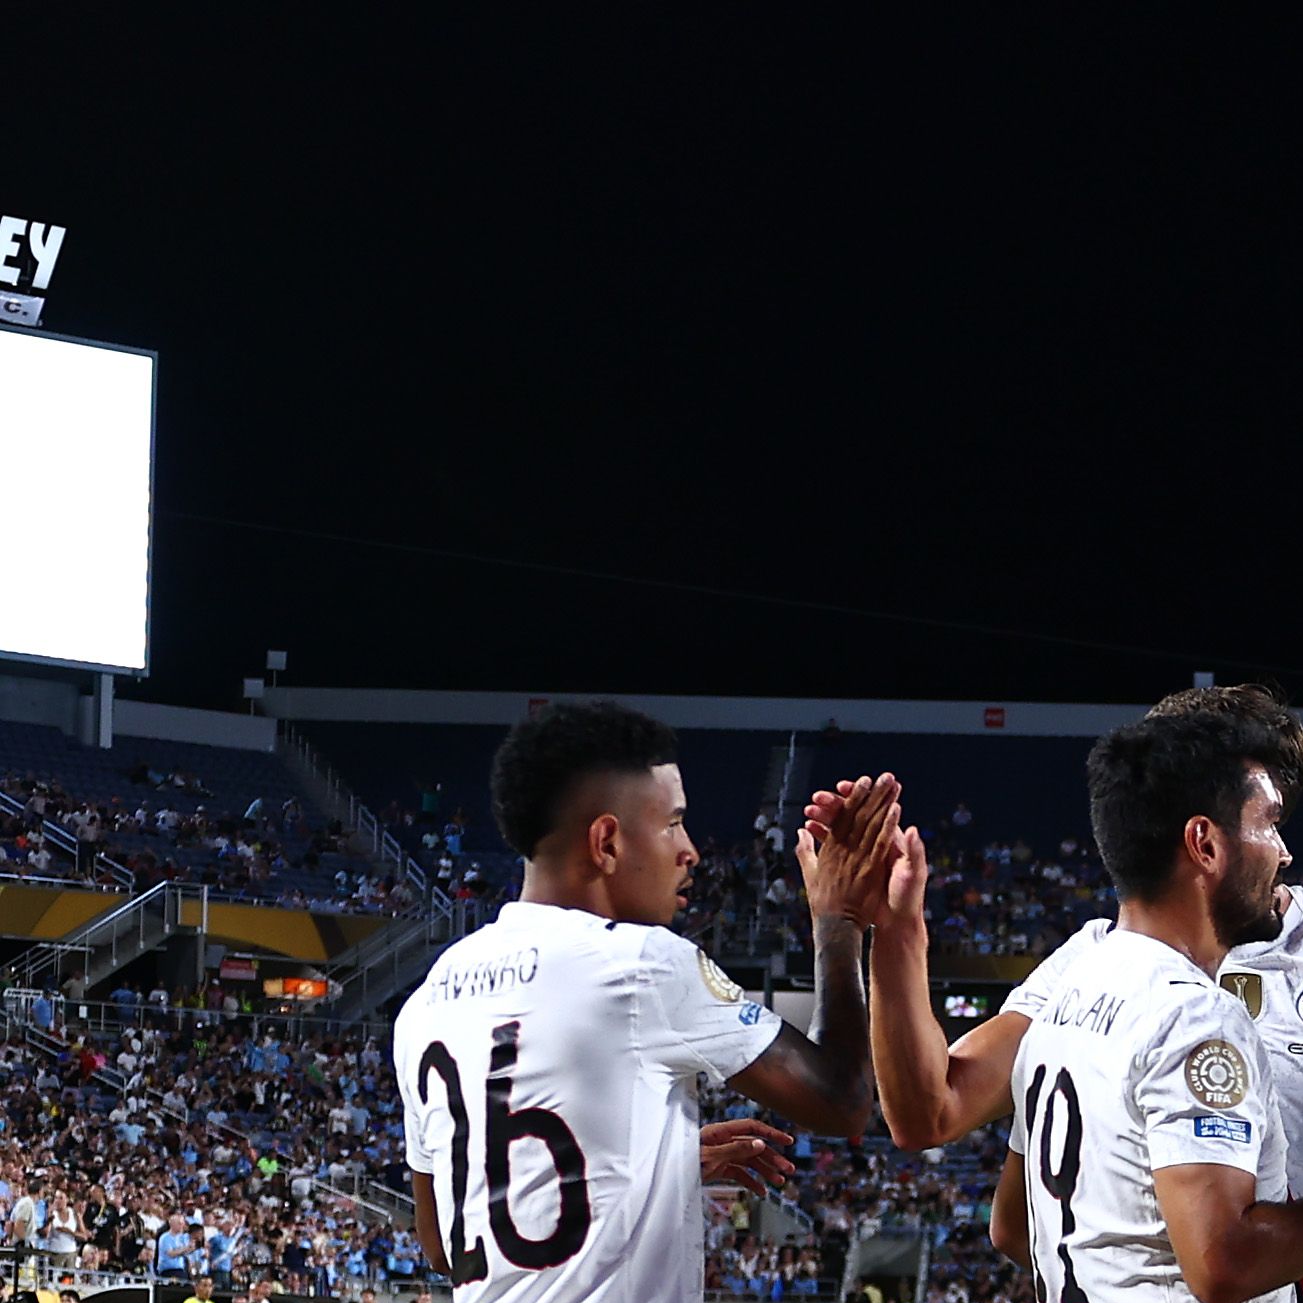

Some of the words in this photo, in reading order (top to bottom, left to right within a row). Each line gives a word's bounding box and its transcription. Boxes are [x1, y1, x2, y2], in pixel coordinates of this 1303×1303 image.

[0, 215, 66, 289] EY
[427, 948, 538, 1005] AVINHO
[1206, 1092, 1231, 1104] FIFA
[418, 1020, 591, 1289] 26
